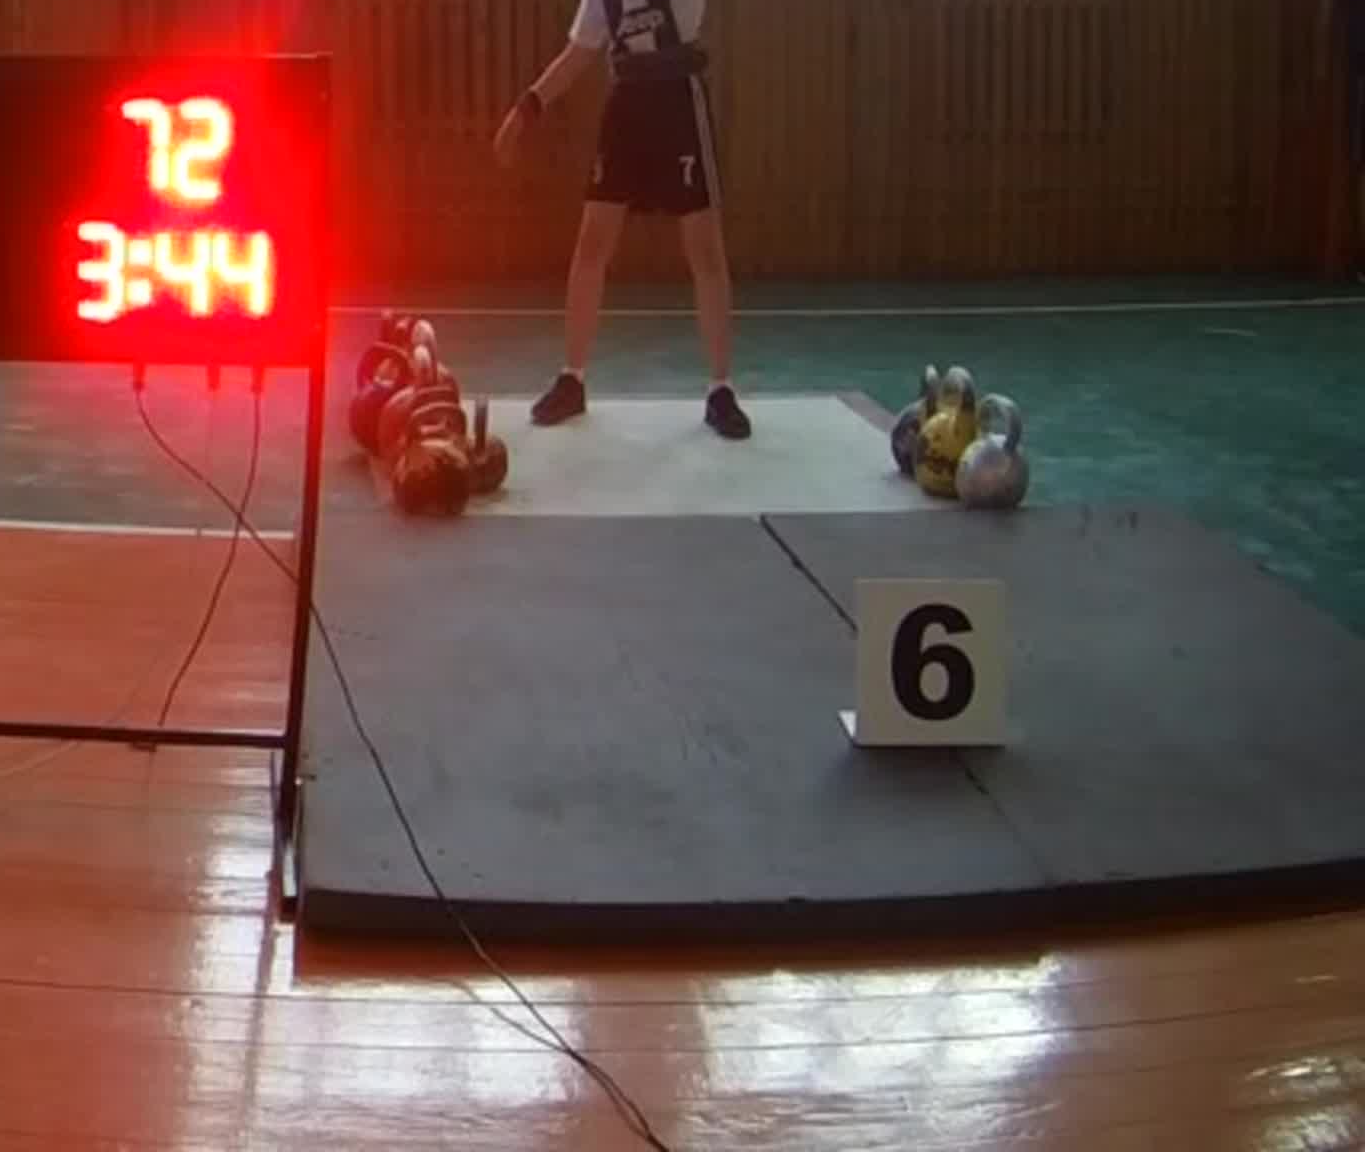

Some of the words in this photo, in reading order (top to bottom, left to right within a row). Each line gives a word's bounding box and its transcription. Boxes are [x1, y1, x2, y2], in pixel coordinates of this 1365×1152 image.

[121, 97, 234, 200] 72
[678, 155, 696, 186] 7
[76, 220, 275, 323] 3:44
[891, 603, 975, 721] 6
